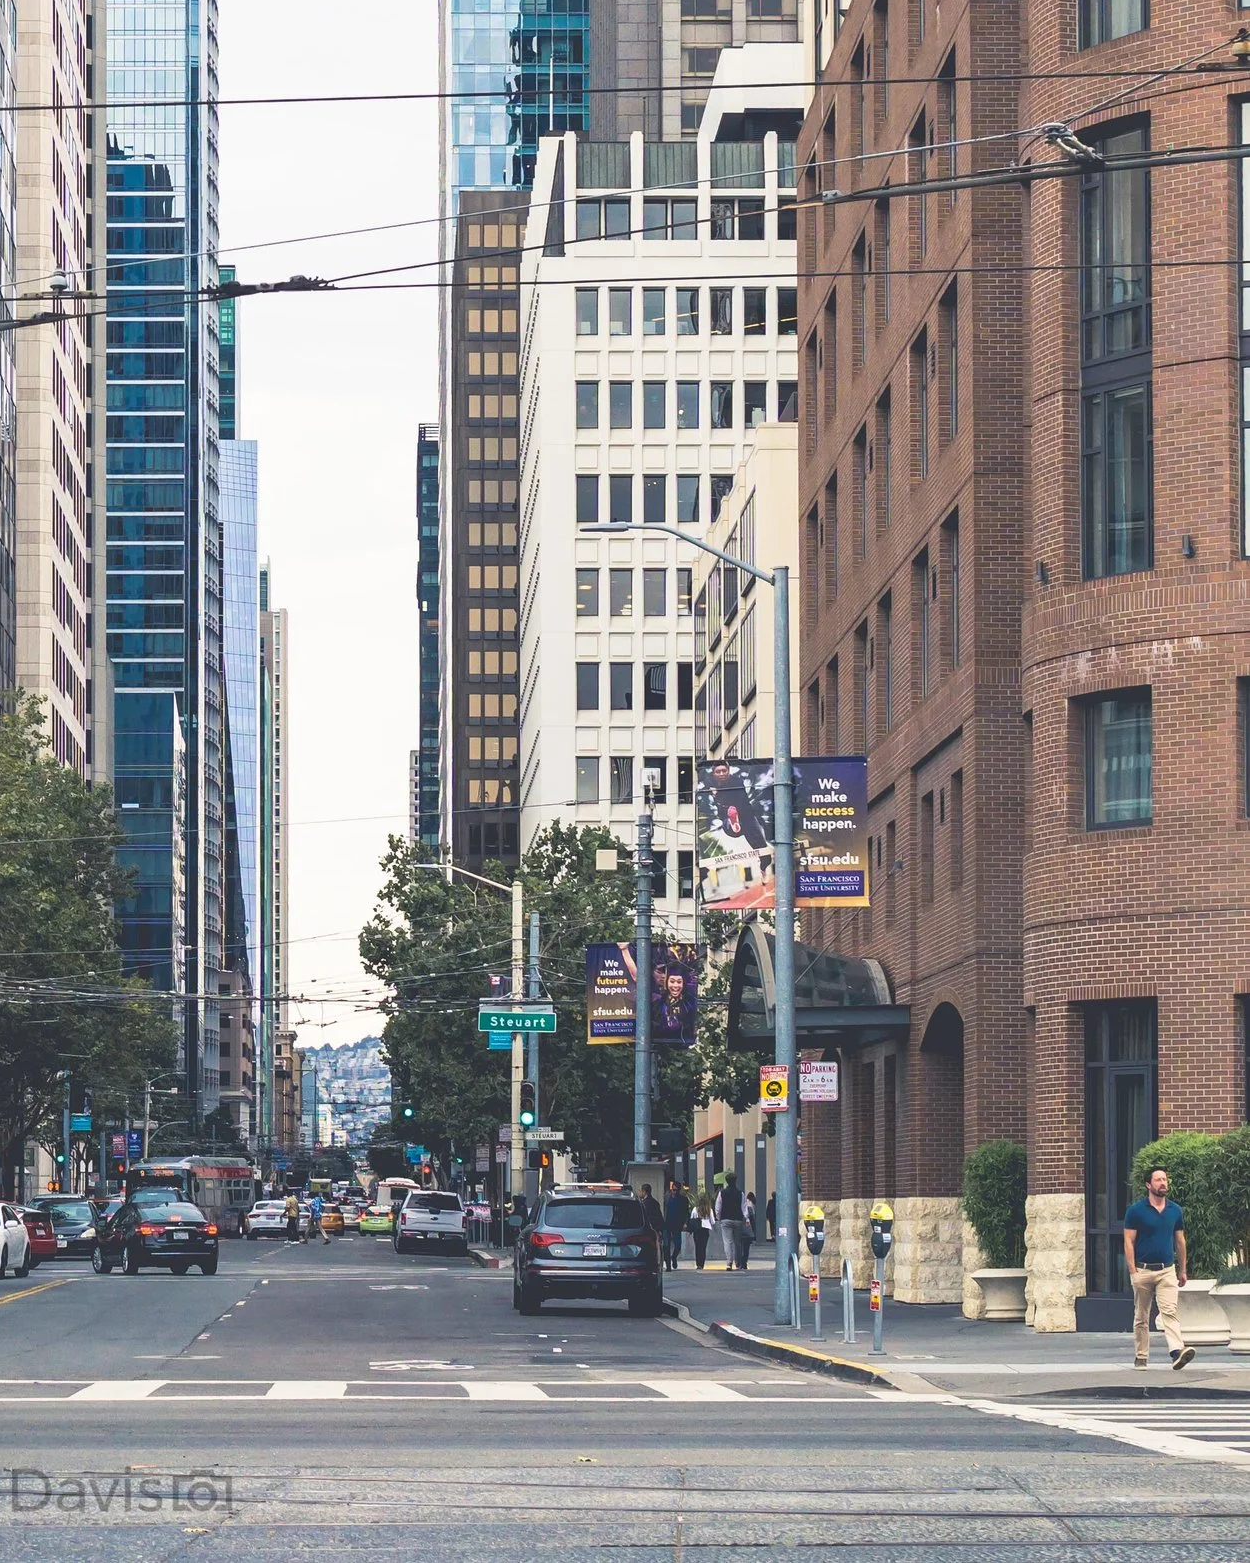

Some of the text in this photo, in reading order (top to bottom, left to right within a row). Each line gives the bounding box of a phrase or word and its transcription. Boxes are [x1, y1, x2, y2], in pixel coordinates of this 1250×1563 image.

[818, 778, 841, 790] We
[811, 791, 848, 803] make
[805, 806, 855, 817] success
[803, 818, 857, 832] happen.
[800, 852, 860, 866] sfsu.edu
[817, 875, 860, 883] FRANCISCO
[604, 959, 619, 968] We
[596, 977, 628, 985] futures
[594, 986, 630, 995] happen.
[593, 1007, 633, 1016] sfsu.edu
[490, 1016, 546, 1028] Steuart
[800, 1063, 836, 1073] NO PARKING
[802, 1075, 808, 1083] 2
[820, 1075, 826, 1083] 6
